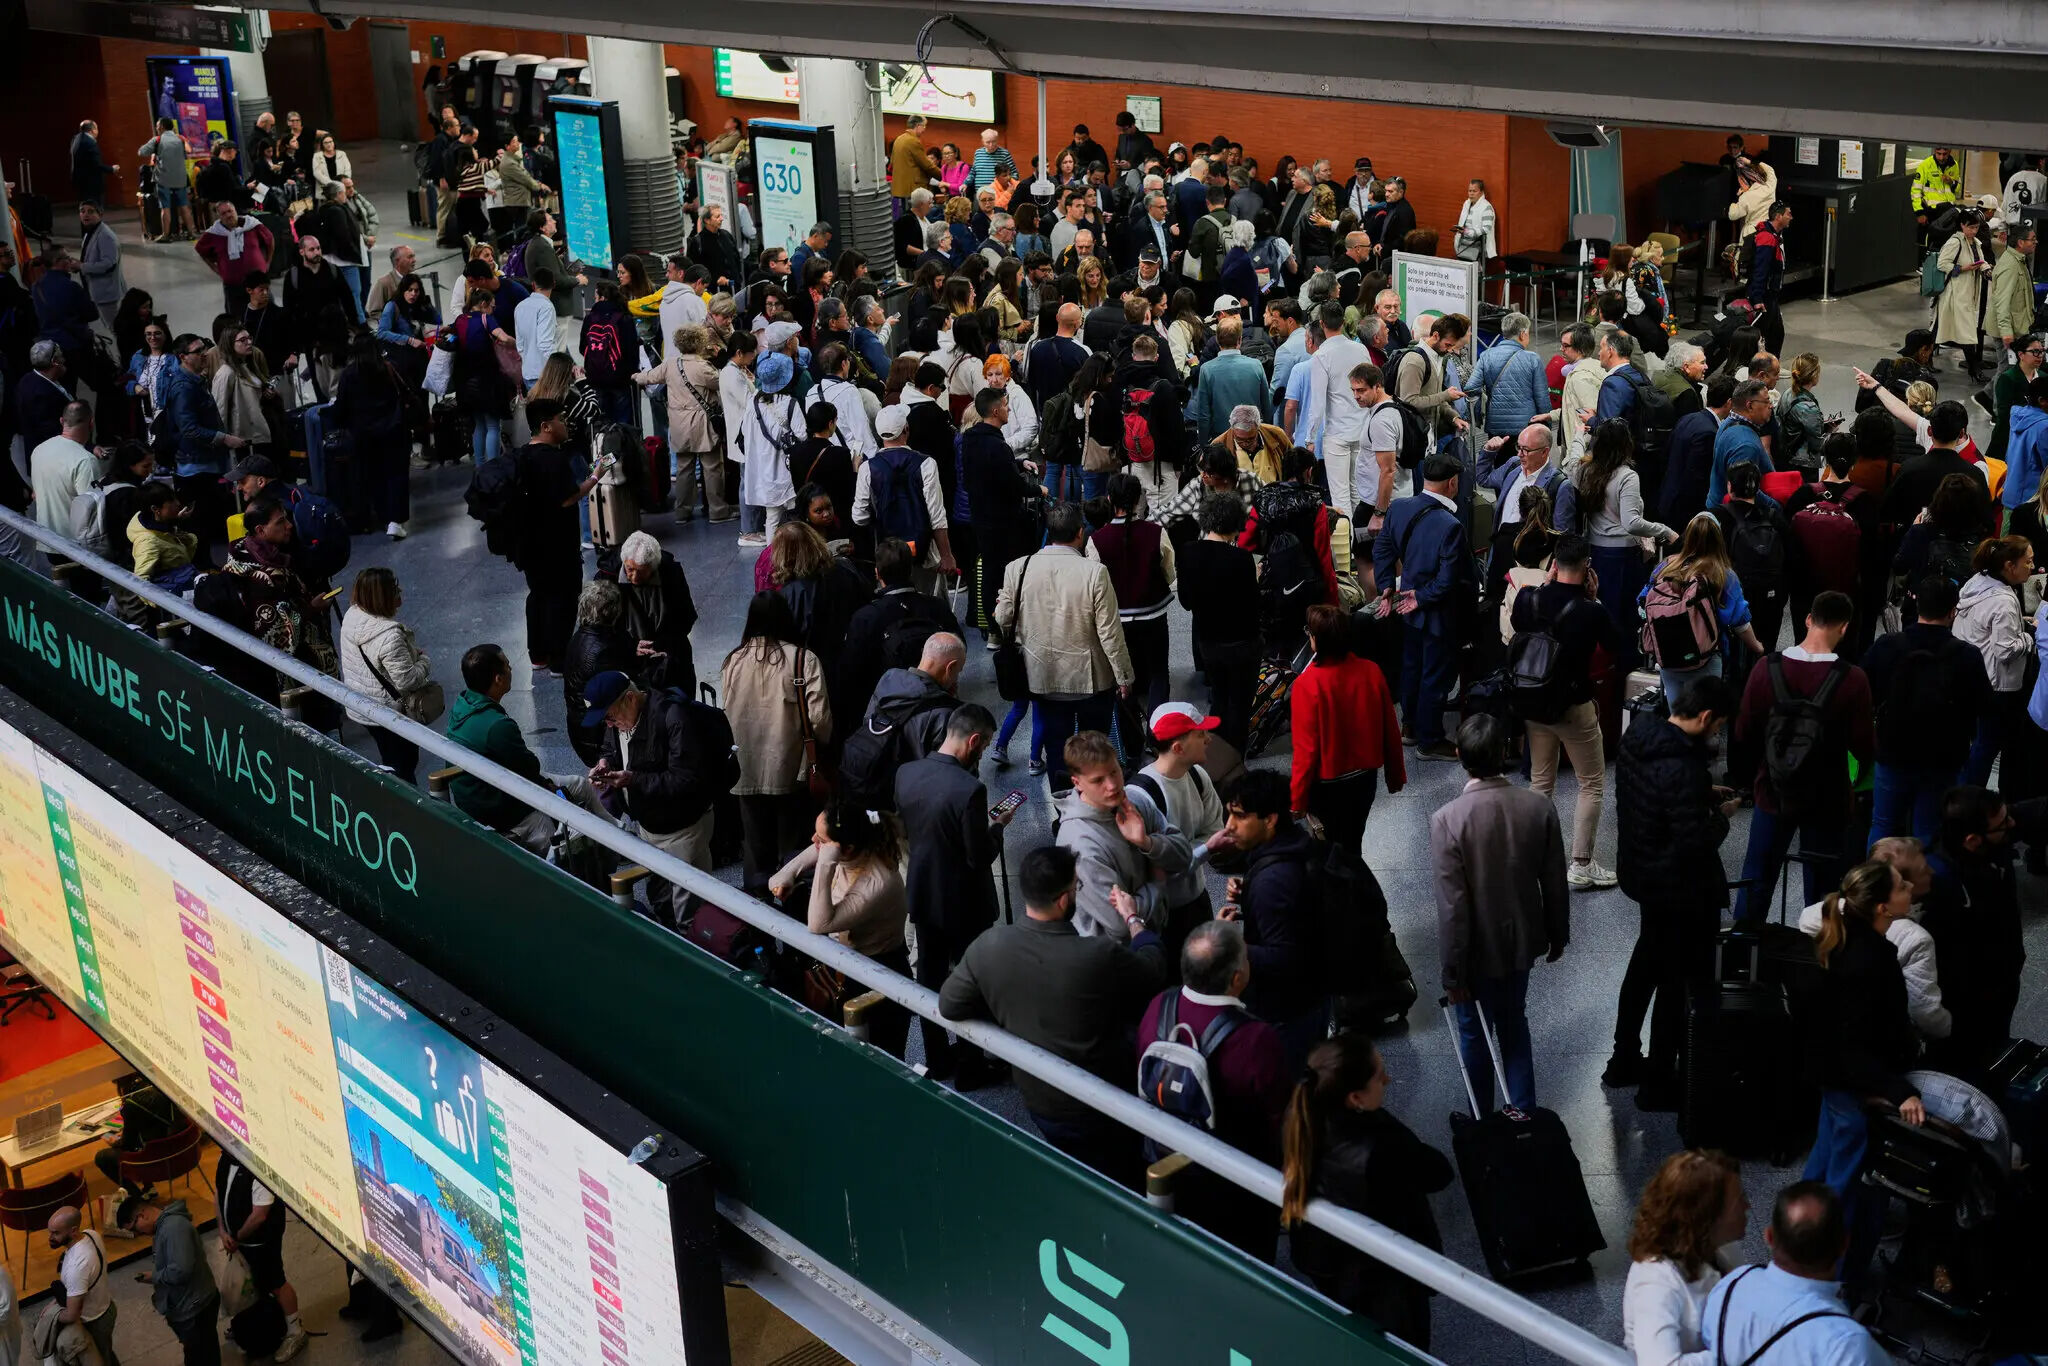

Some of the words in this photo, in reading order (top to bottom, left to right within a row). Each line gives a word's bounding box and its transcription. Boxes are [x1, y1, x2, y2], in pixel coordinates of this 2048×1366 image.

[763, 162, 802, 195] 630
[3, 595, 61, 669] MÁS
[67, 634, 152, 727] NUBE.
[158, 689, 196, 756] SÉ
[203, 716, 276, 805] MÁS
[288, 767, 419, 897] ELROQ
[194, 931, 214, 952] avlo
[200, 982, 218, 1007] iryo
[354, 975, 379, 1001] Objetos
